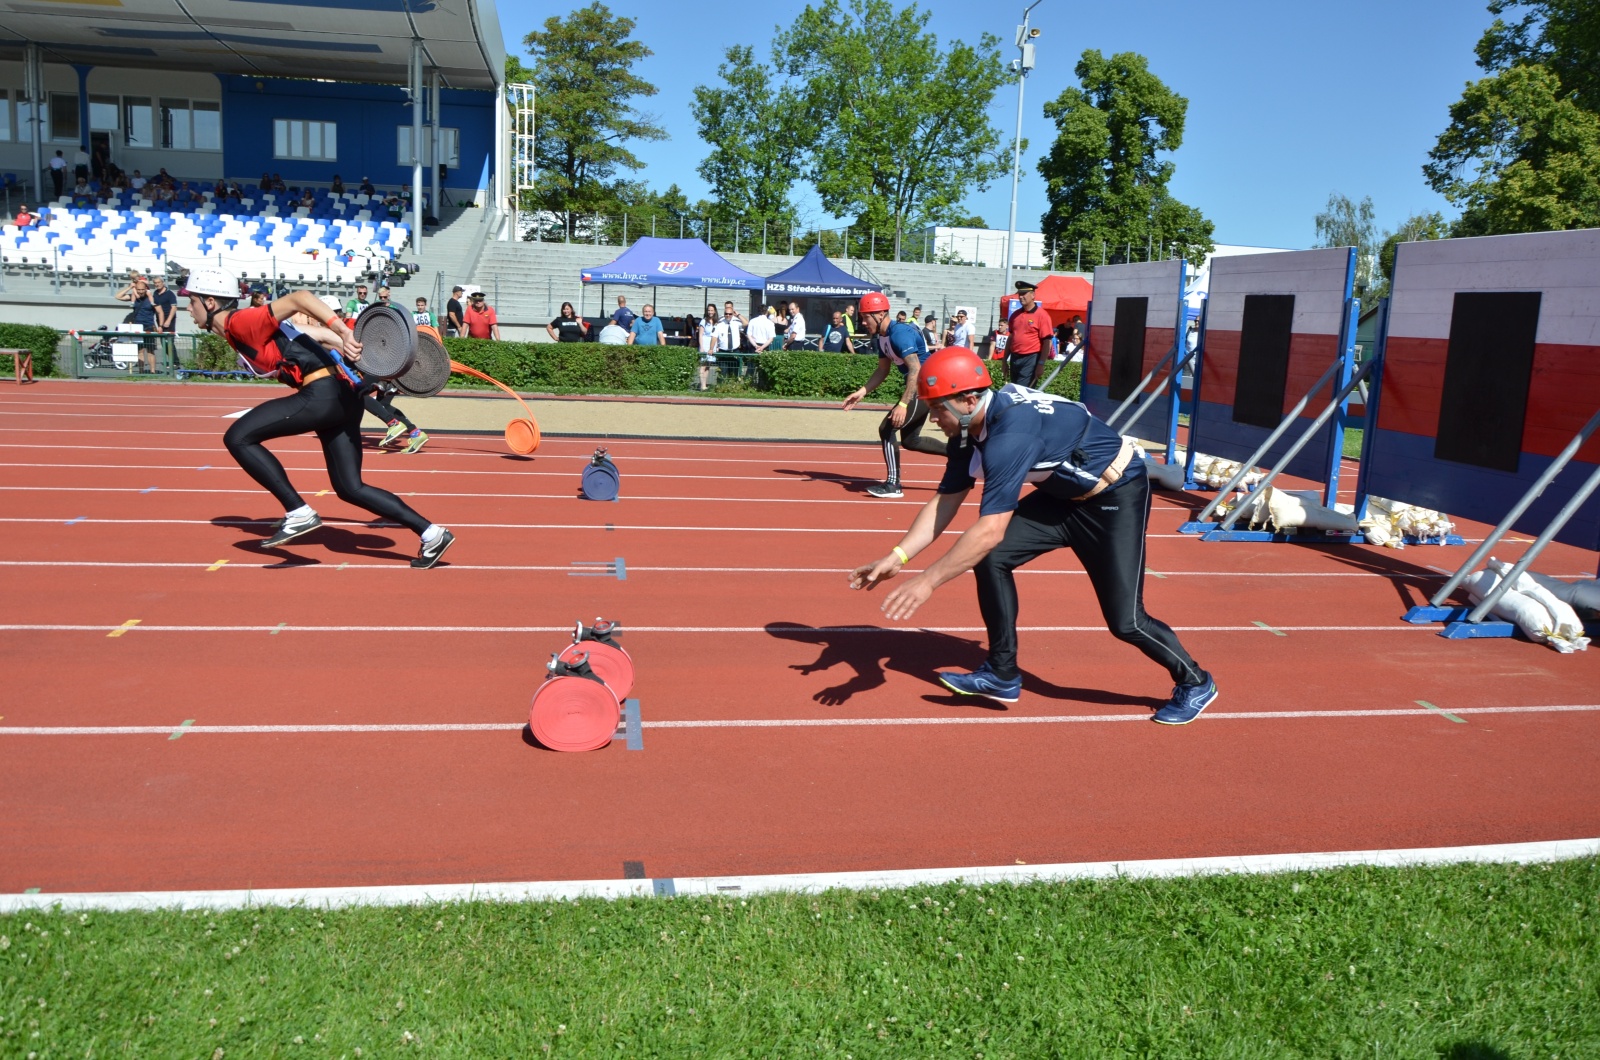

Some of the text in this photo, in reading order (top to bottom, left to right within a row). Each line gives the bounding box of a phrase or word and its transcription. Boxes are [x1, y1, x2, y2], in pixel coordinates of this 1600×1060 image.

[602, 272, 647, 281] www.hvp.cz
[701, 277, 746, 286] www.hvp.cz
[766, 283, 785, 292] HZS
[787, 284, 852, 295] Středočeského
[416, 315, 429, 326] 168
